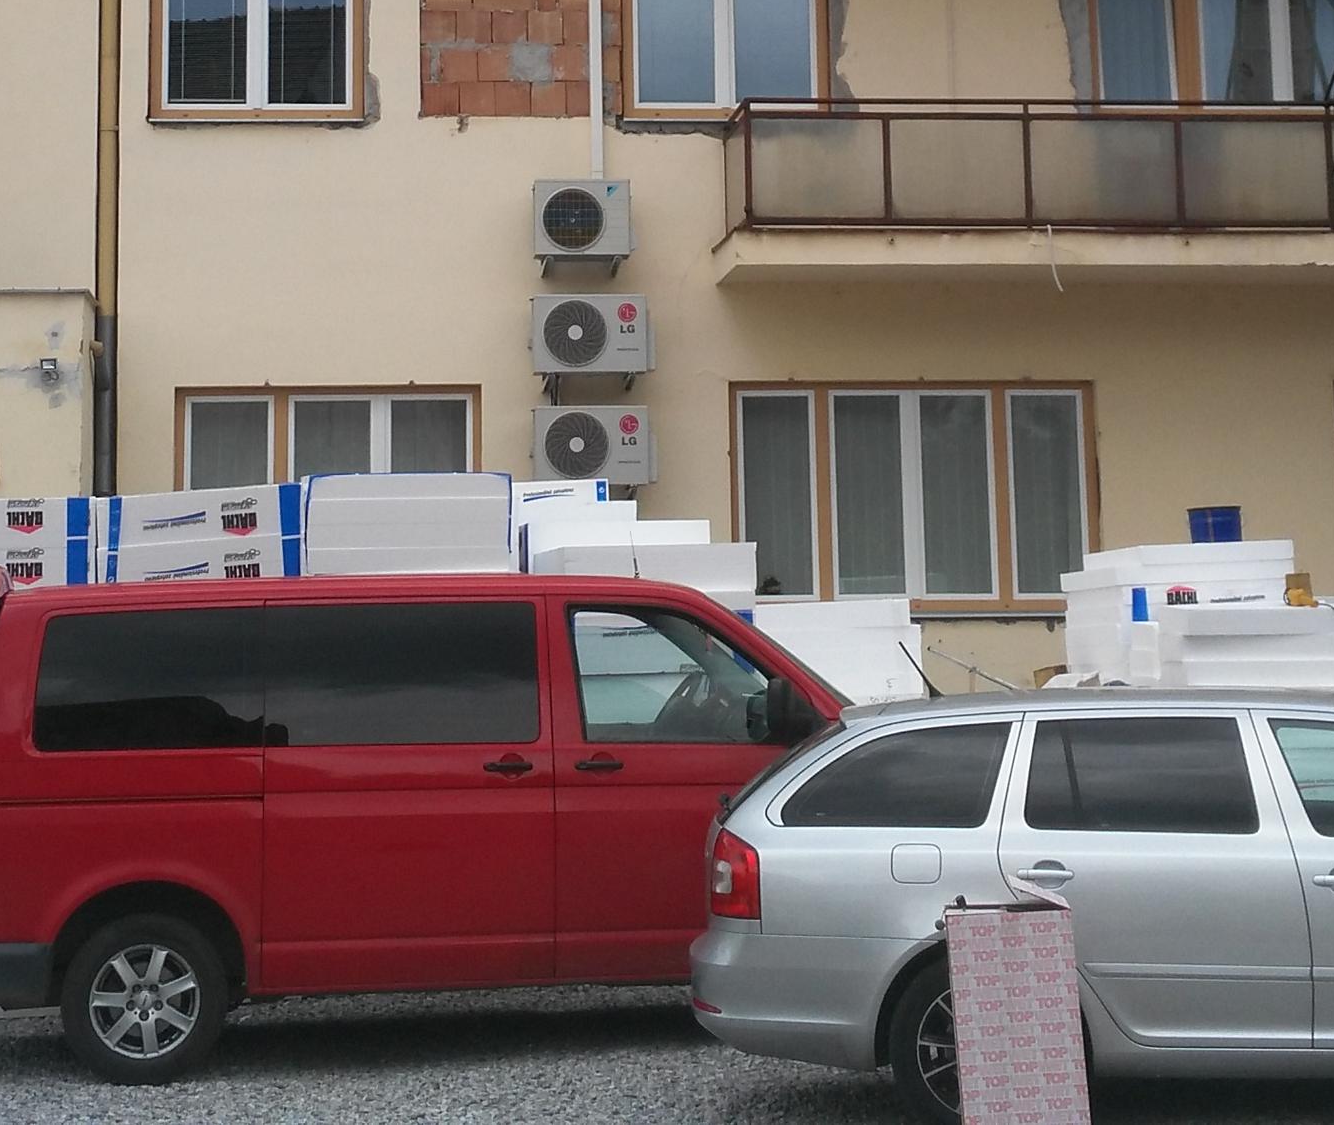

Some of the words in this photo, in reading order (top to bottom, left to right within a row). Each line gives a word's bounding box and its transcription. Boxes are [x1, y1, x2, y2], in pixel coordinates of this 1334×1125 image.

[620, 324, 635, 334] LG
[621, 436, 637, 446] LG
[969, 926, 995, 937] TOP
[1029, 922, 1056, 933] TOP
[1001, 936, 1026, 947] TOP
[972, 951, 998, 962] TOP
[1031, 947, 1058, 958] TOP
[1003, 962, 1028, 972] TOP
[974, 976, 1000, 987] TOP
[1034, 973, 1060, 983] TOP
[1005, 987, 1030, 997] TOP
[977, 1001, 1003, 1011] TOP
[1036, 998, 1063, 1008] TOP
[1007, 1012, 1033, 1022] TOP
[981, 1026, 1004, 1036] TOP
[1040, 1023, 1065, 1033] TOP
[1009, 1037, 1035, 1047] TOP
[981, 1051, 1007, 1062] TOP
[1042, 1048, 1067, 1059] TOP
[1012, 1062, 1037, 1073] TOP
[983, 1076, 1009, 1087] TOP
[1044, 1073, 1069, 1084] TOP
[1014, 1087, 1040, 1097] TOP
[985, 1102, 1012, 1113] TOP
[1046, 1099, 1072, 1109] TOP
[1016, 1112, 1042, 1123] TOP
